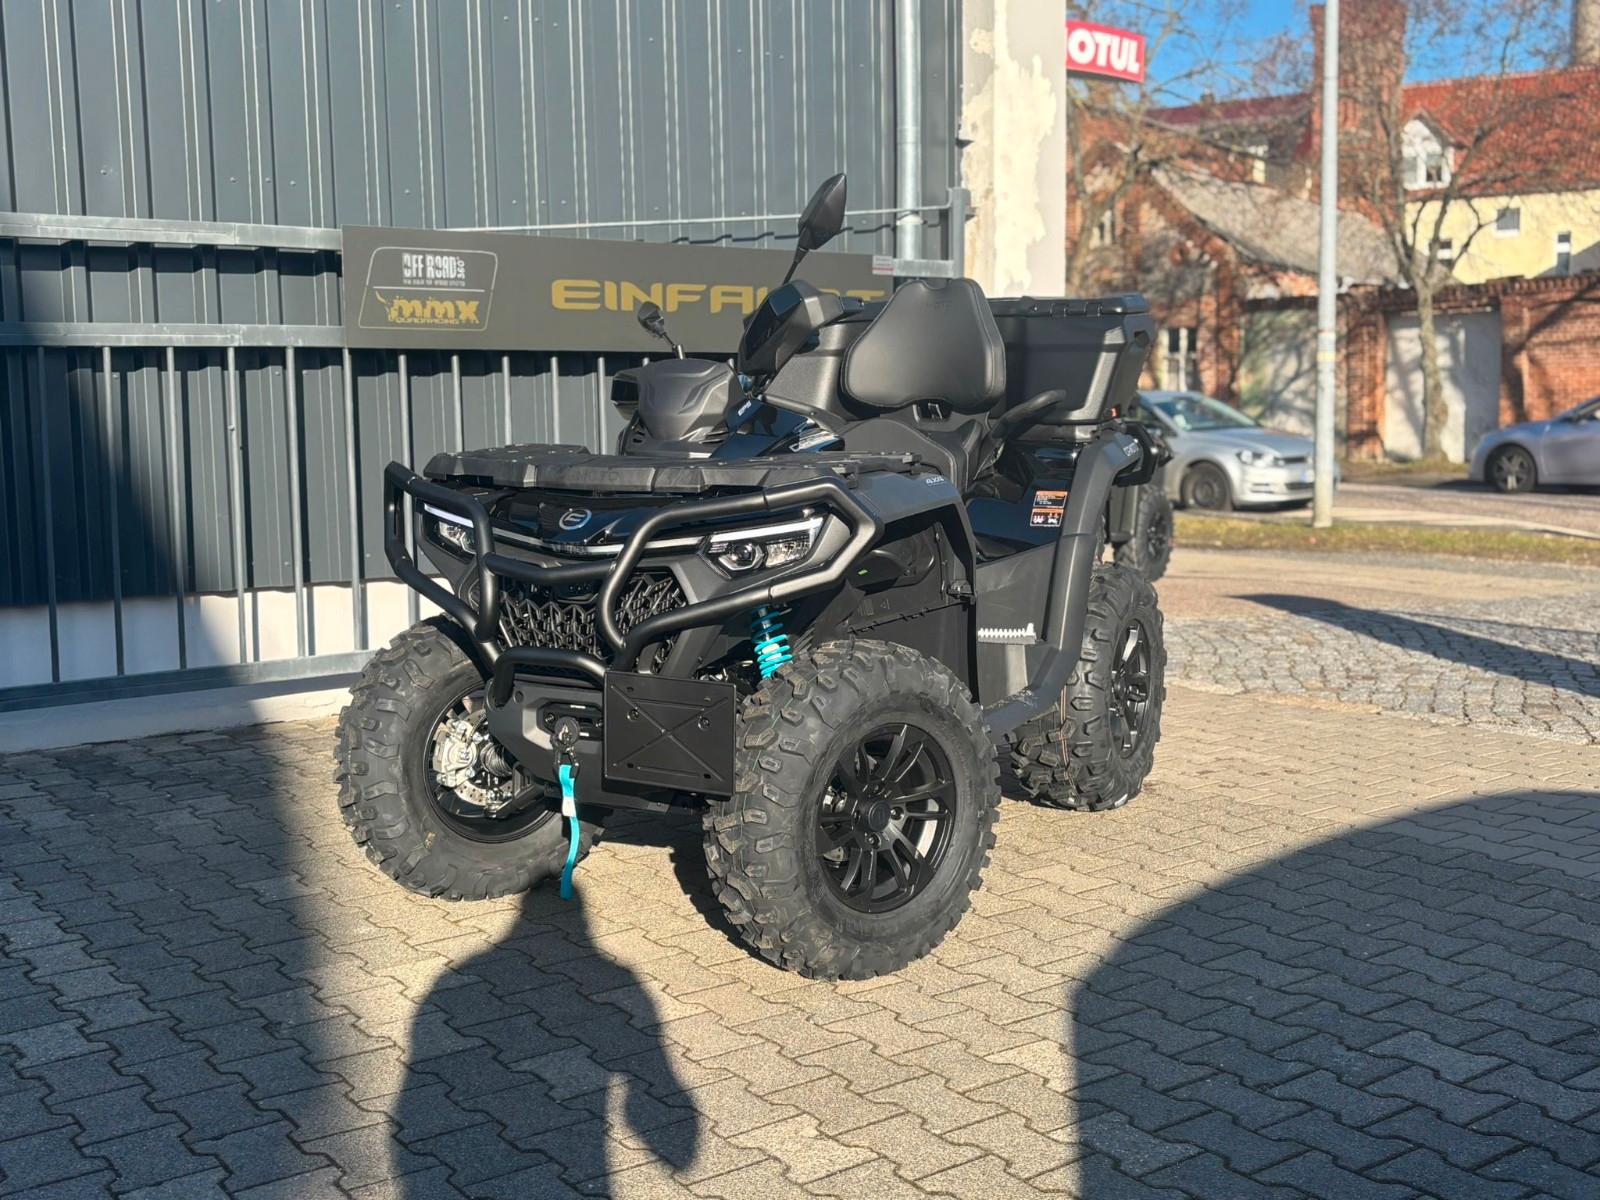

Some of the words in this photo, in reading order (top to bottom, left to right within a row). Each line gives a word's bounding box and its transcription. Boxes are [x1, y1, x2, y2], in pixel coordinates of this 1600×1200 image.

[1067, 28, 1140, 74] OTUL
[402, 253, 424, 278] OFF
[426, 254, 457, 279] ROAD
[551, 279, 885, 314] EINFAT
